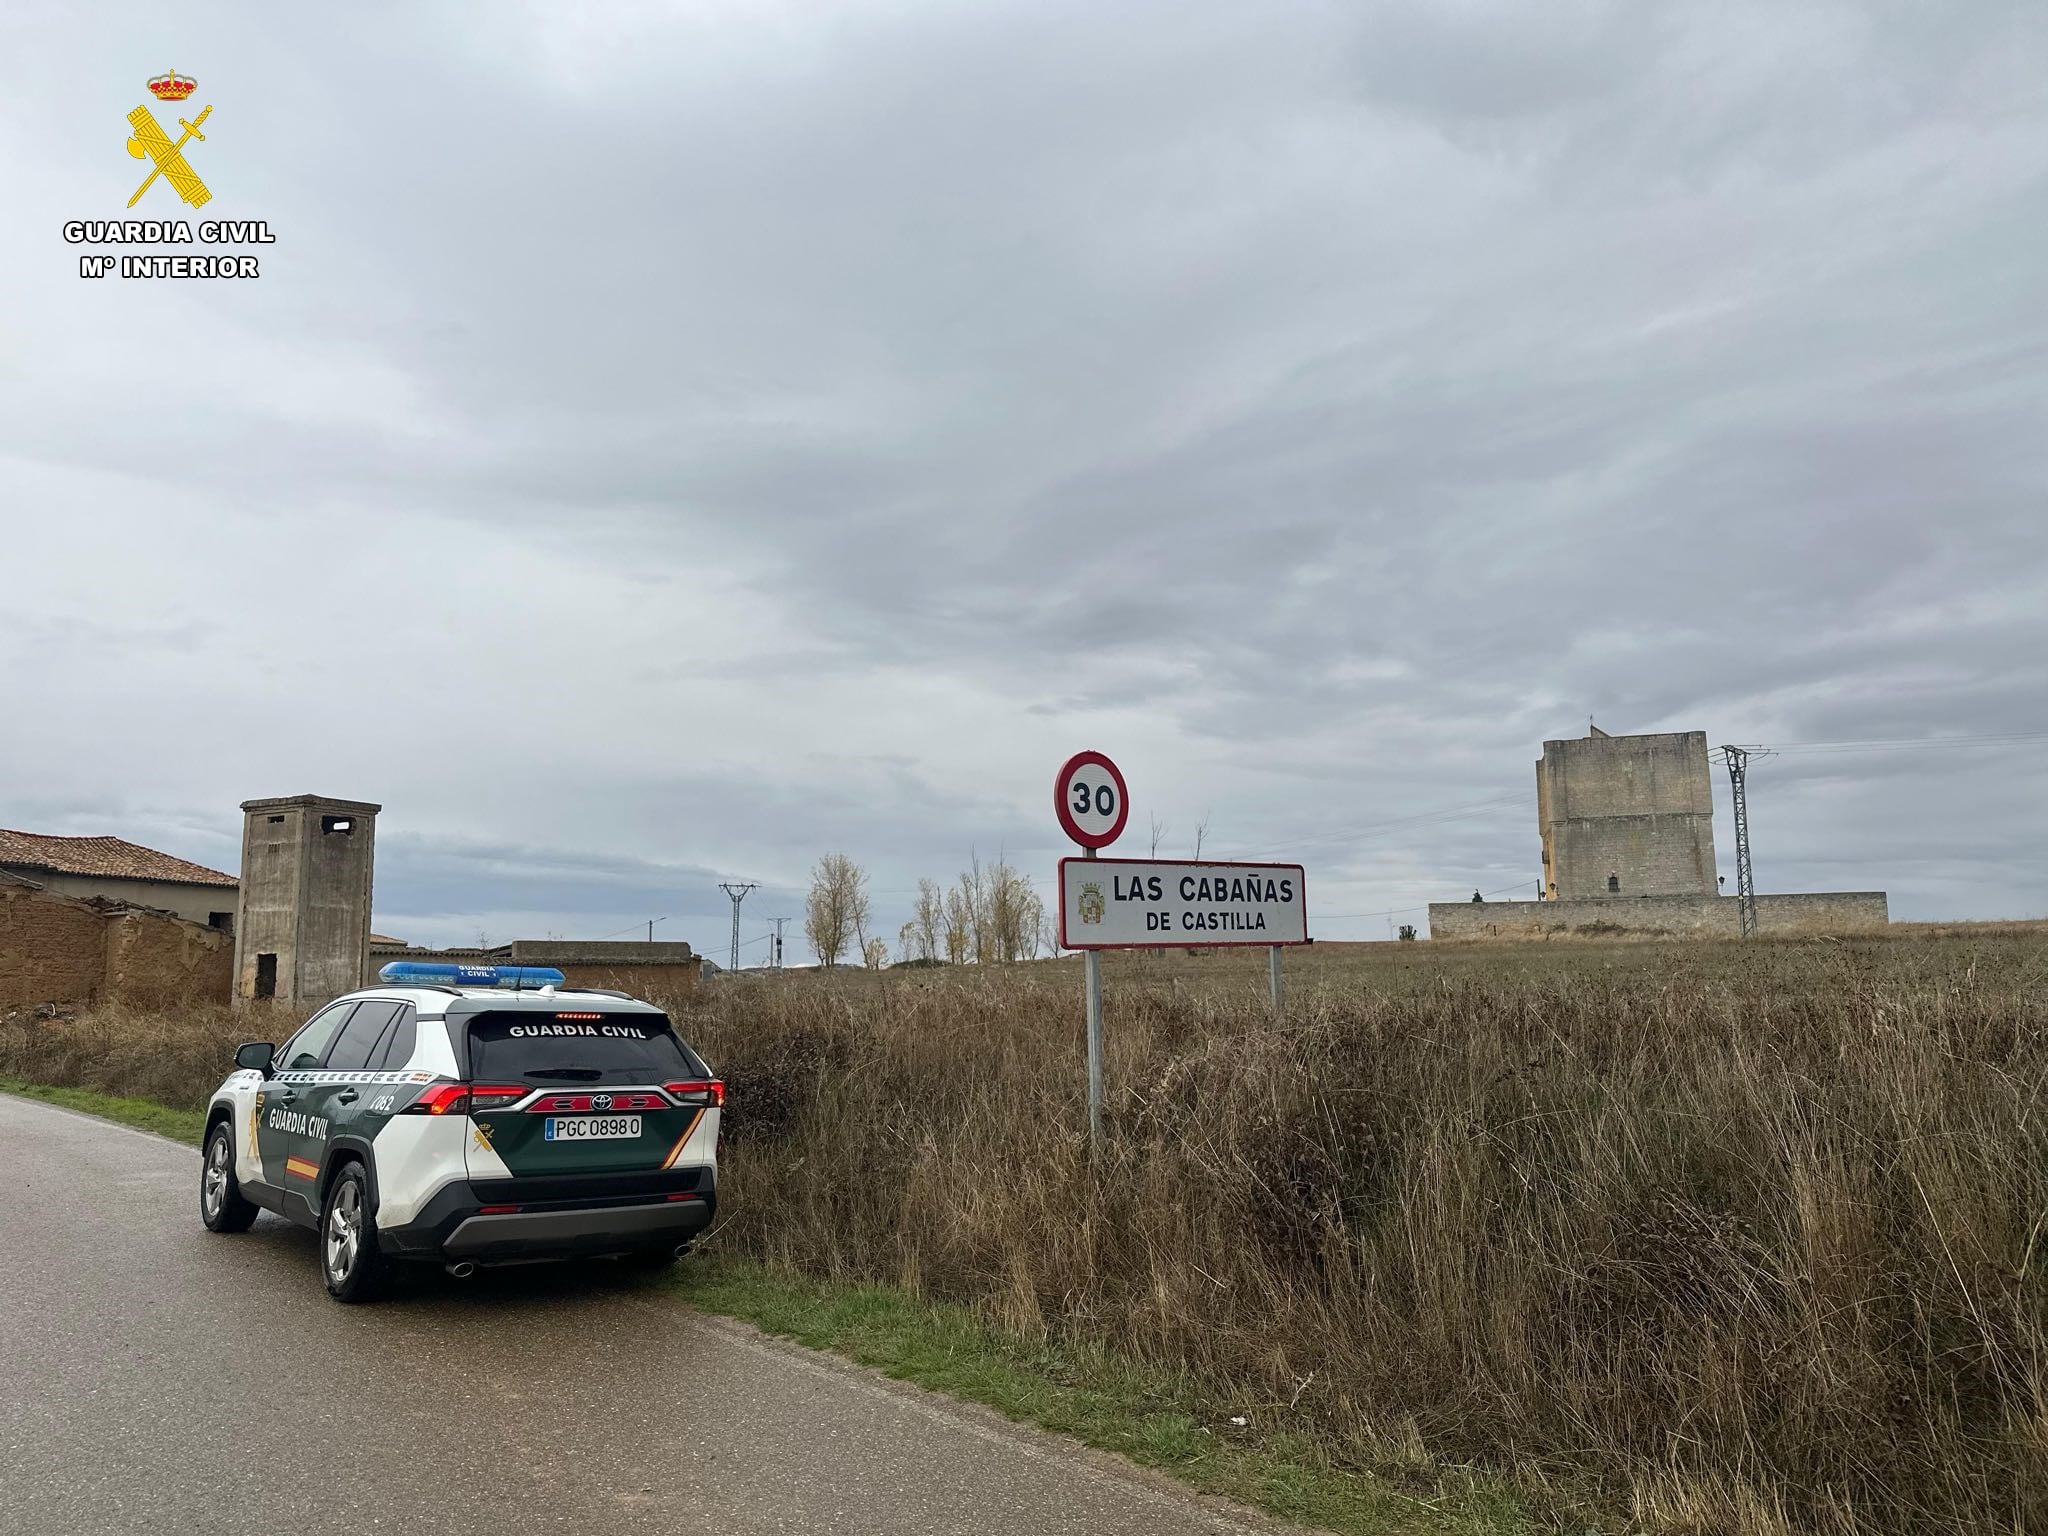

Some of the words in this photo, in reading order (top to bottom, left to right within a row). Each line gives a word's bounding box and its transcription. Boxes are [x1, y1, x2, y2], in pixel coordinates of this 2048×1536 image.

[1073, 782, 1115, 816] 30
[1113, 875, 1163, 902] LAS
[1179, 873, 1294, 903] CABAÑAS
[1146, 911, 1171, 931] DE
[1182, 911, 1266, 931] CASTILLA
[509, 1025, 598, 1037] GUARDIA
[601, 1026, 647, 1039] CIVIL
[269, 1108, 306, 1135] GUARDIA
[308, 1116, 329, 1141] CIVIL
[556, 1120, 587, 1138] PGC
